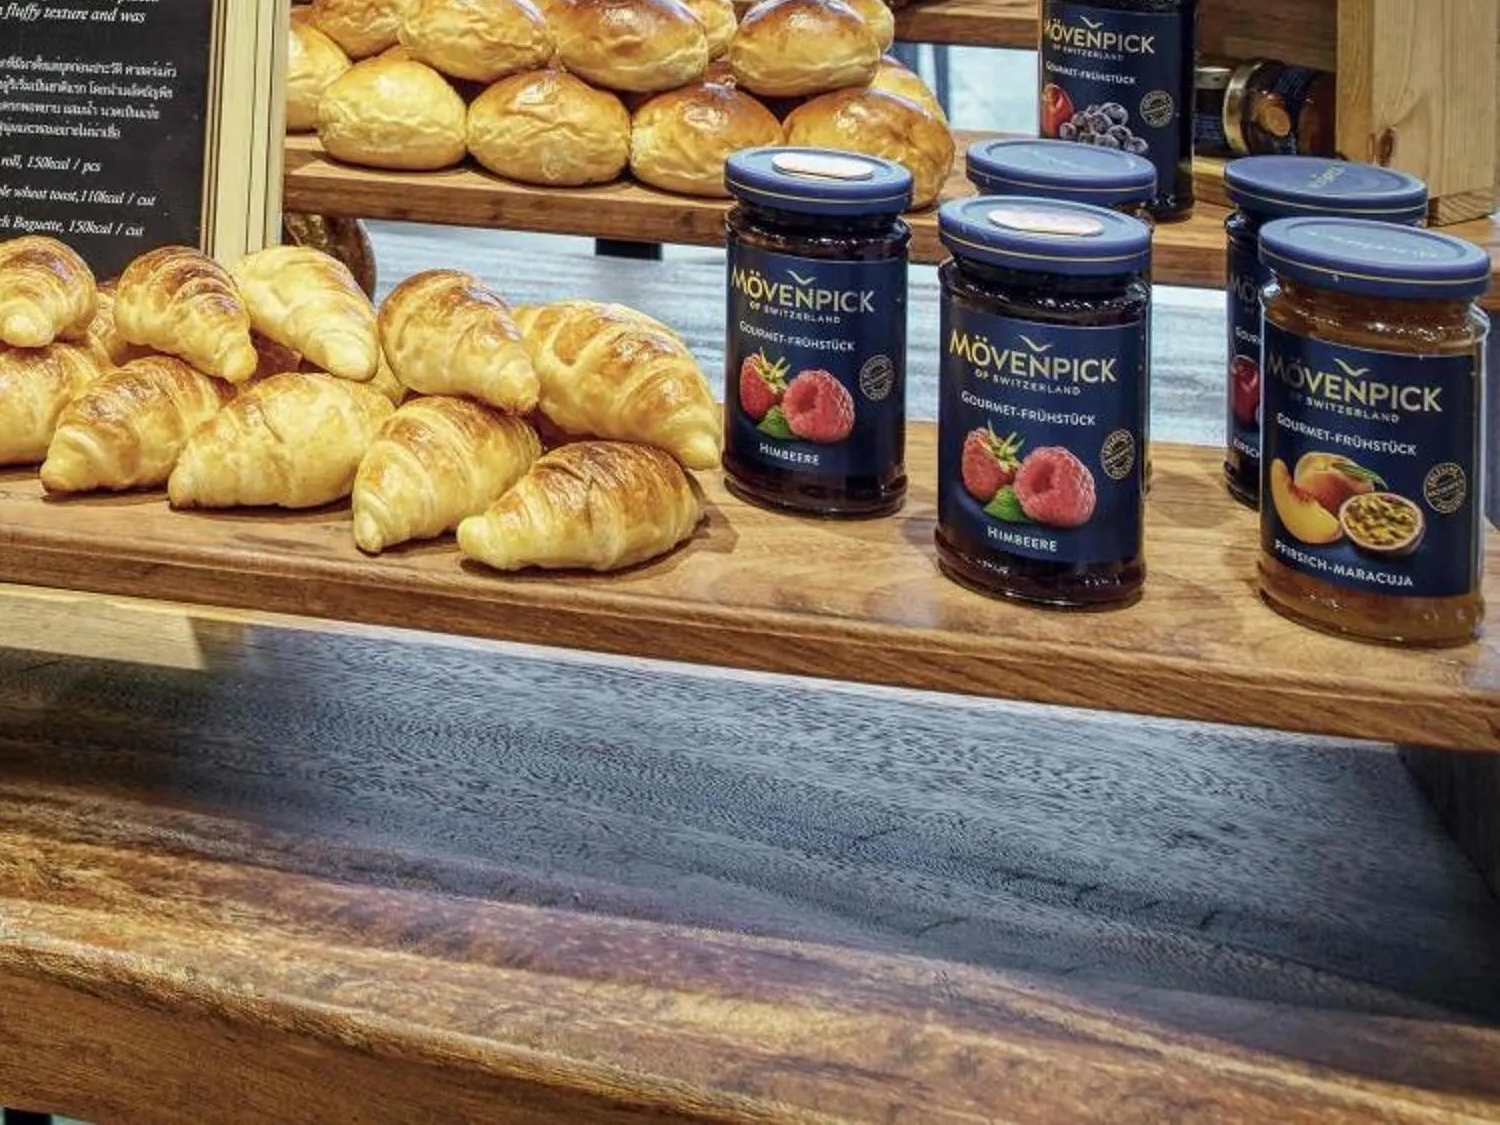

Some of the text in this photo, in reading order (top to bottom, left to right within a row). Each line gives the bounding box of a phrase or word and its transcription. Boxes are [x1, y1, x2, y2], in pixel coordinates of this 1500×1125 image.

[4, 3, 43, 21] fluffy
[43, 7, 89, 20] texture
[90, 7, 119, 22] and
[121, 11, 146, 23] was
[81, 161, 101, 175] pcs
[13, 186, 49, 199] wheat
[731, 265, 876, 313] MÖVENPICK
[764, 306, 841, 324] SWITZERLAND
[739, 320, 856, 352] GOURMET-FRÜHSTÜCK
[949, 328, 1117, 383] MÖVENPICK
[975, 369, 1081, 396] OF SWITZERLAND
[1267, 351, 1444, 413] MÖVENPICK
[961, 390, 1095, 426] GOURMET-FRÜHSTÜCK
[1306, 397, 1400, 424] SWITZERLAND
[1275, 412, 1417, 457] GOURMET-FRÜHSTÜCK
[759, 443, 820, 465] HIMBEERE
[987, 526, 1057, 552] HIMBEERE
[1274, 541, 1414, 587] PFIRSICH-MARACUJA
